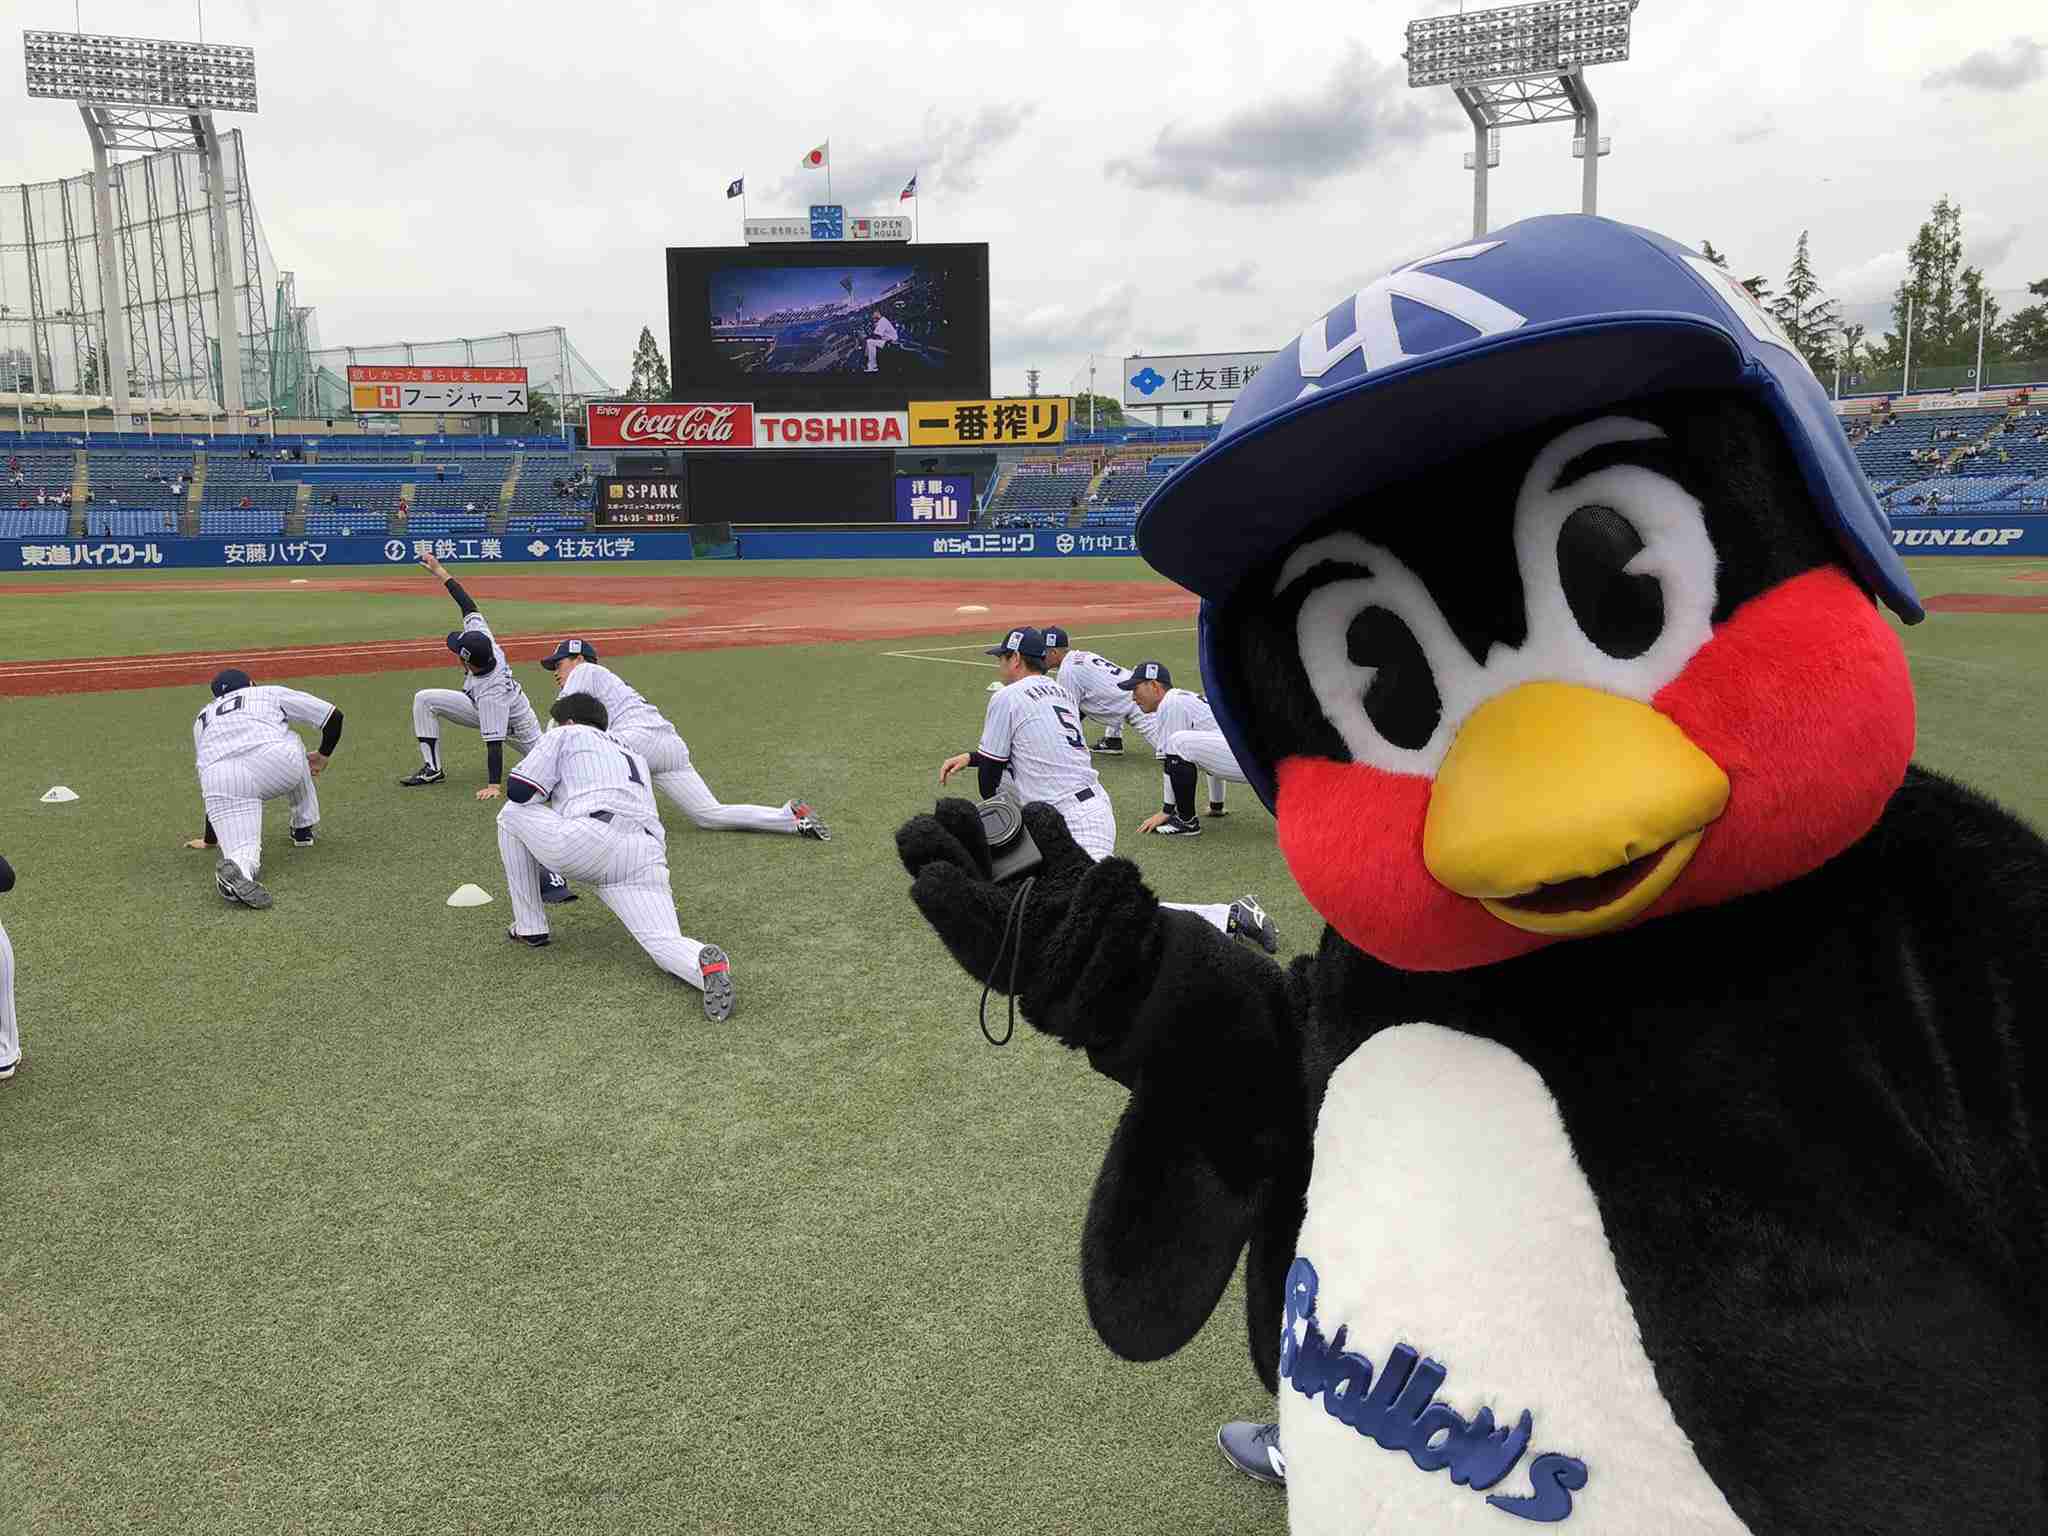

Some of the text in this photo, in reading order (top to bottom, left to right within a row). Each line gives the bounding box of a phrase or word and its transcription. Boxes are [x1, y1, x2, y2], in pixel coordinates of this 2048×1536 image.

[873, 220, 902, 229] OPEN
[1851, 377, 1857, 385] E
[1968, 369, 1976, 378] D
[404, 386, 524, 408] フージャース
[620, 406, 737, 441] Coca-Cola
[760, 418, 903, 442] TOSHIBA
[918, 405, 1059, 440] 一番搾り
[627, 484, 678, 499] S-PARK
[912, 480, 955, 494] 洋服の
[910, 496, 957, 520] 青山
[224, 542, 327, 563] 安藤ハザマ
[412, 539, 503, 559] 東鉄工業
[555, 538, 635, 558] 住友化学
[933, 534, 1035, 554] めちゃコミック
[21, 545, 163, 566] 東進ハイスクール
[198, 695, 243, 730] 10
[1052, 705, 1085, 749] 5
[619, 750, 645, 786] 1
[1280, 1257, 1588, 1522] Swallows
